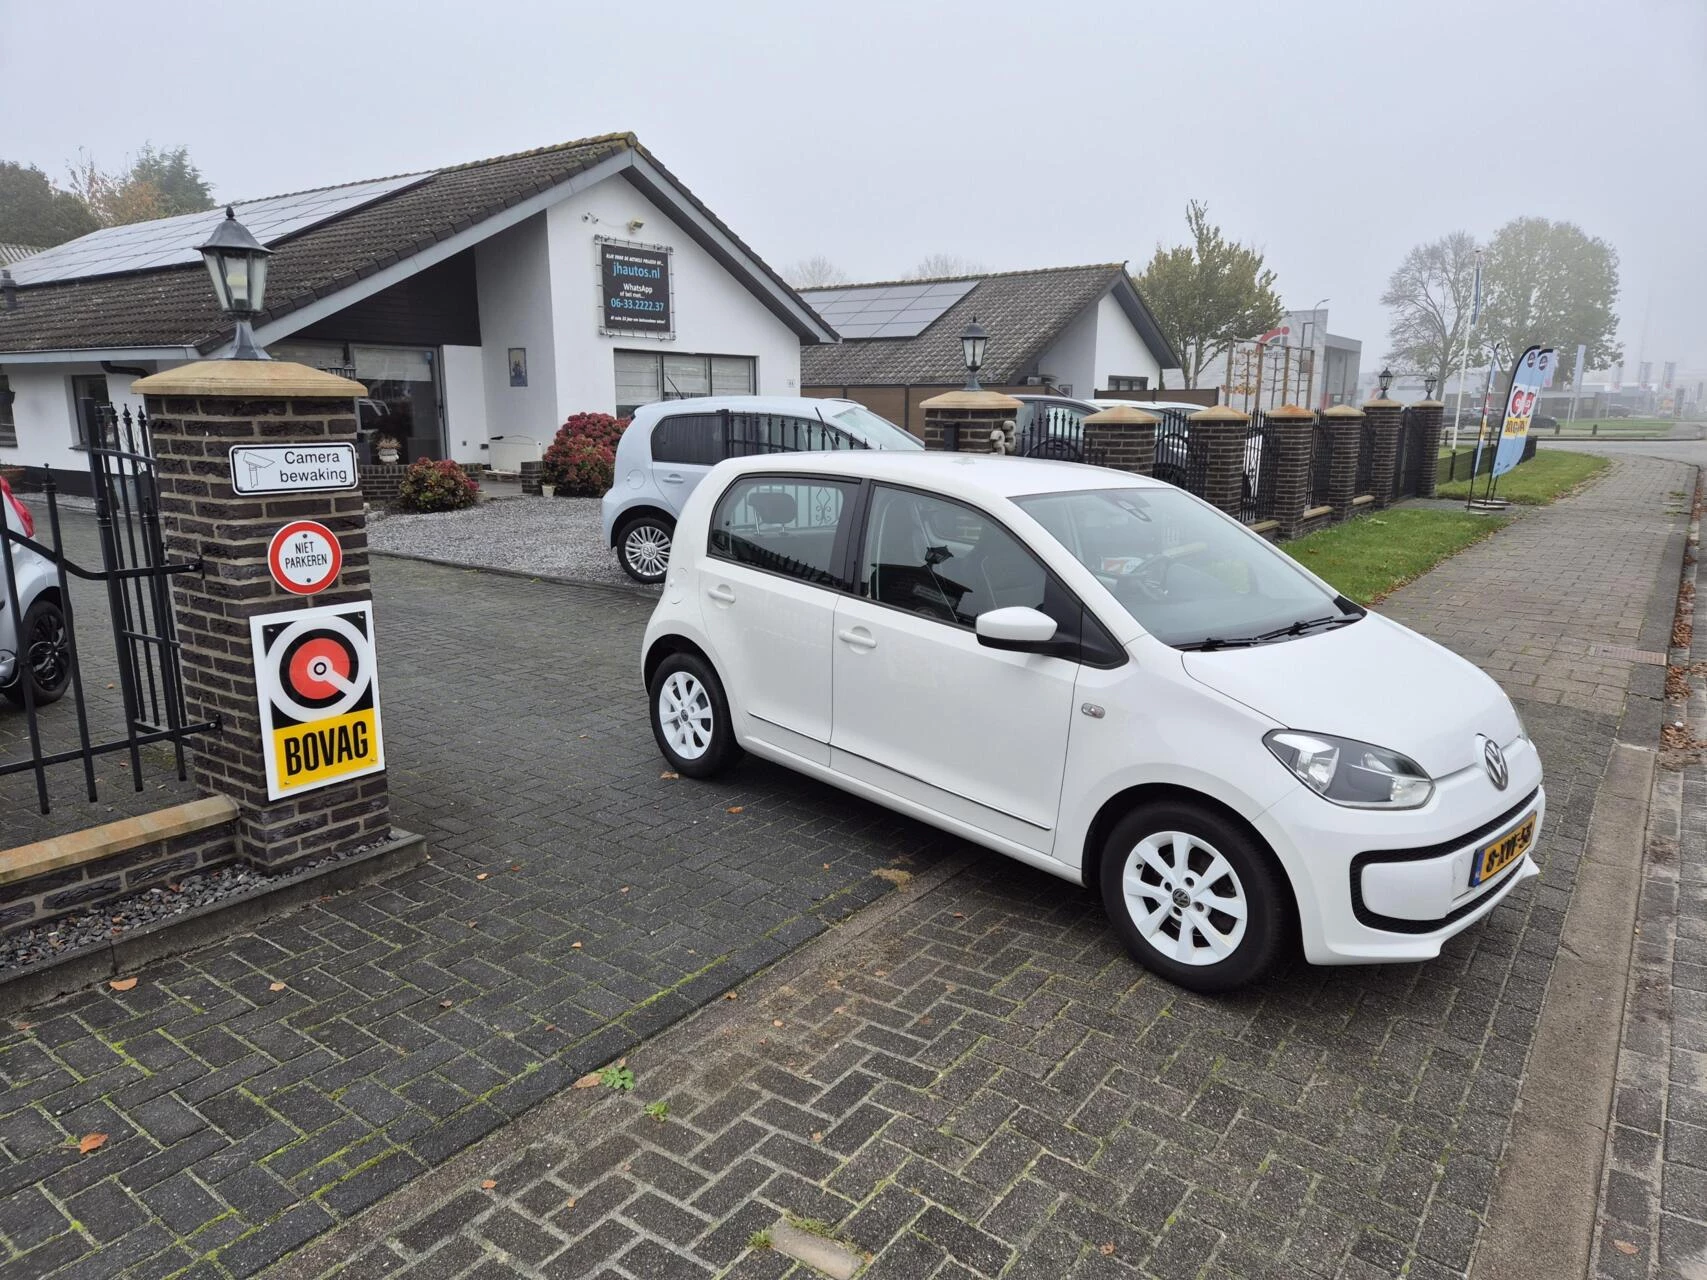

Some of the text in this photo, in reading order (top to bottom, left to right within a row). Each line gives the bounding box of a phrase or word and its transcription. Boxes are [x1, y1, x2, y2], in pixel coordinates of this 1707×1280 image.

[613, 261, 660, 279] jhautos.nl
[623, 283, 653, 294] WhatsApp
[610, 297, 664, 312] 06-33.2222.37
[284, 451, 340, 464] Camera
[280, 468, 347, 483] bewaking
[295, 541, 314, 554] NIET
[285, 554, 328, 569] PARKEREN
[284, 721, 369, 776] BOVAG
